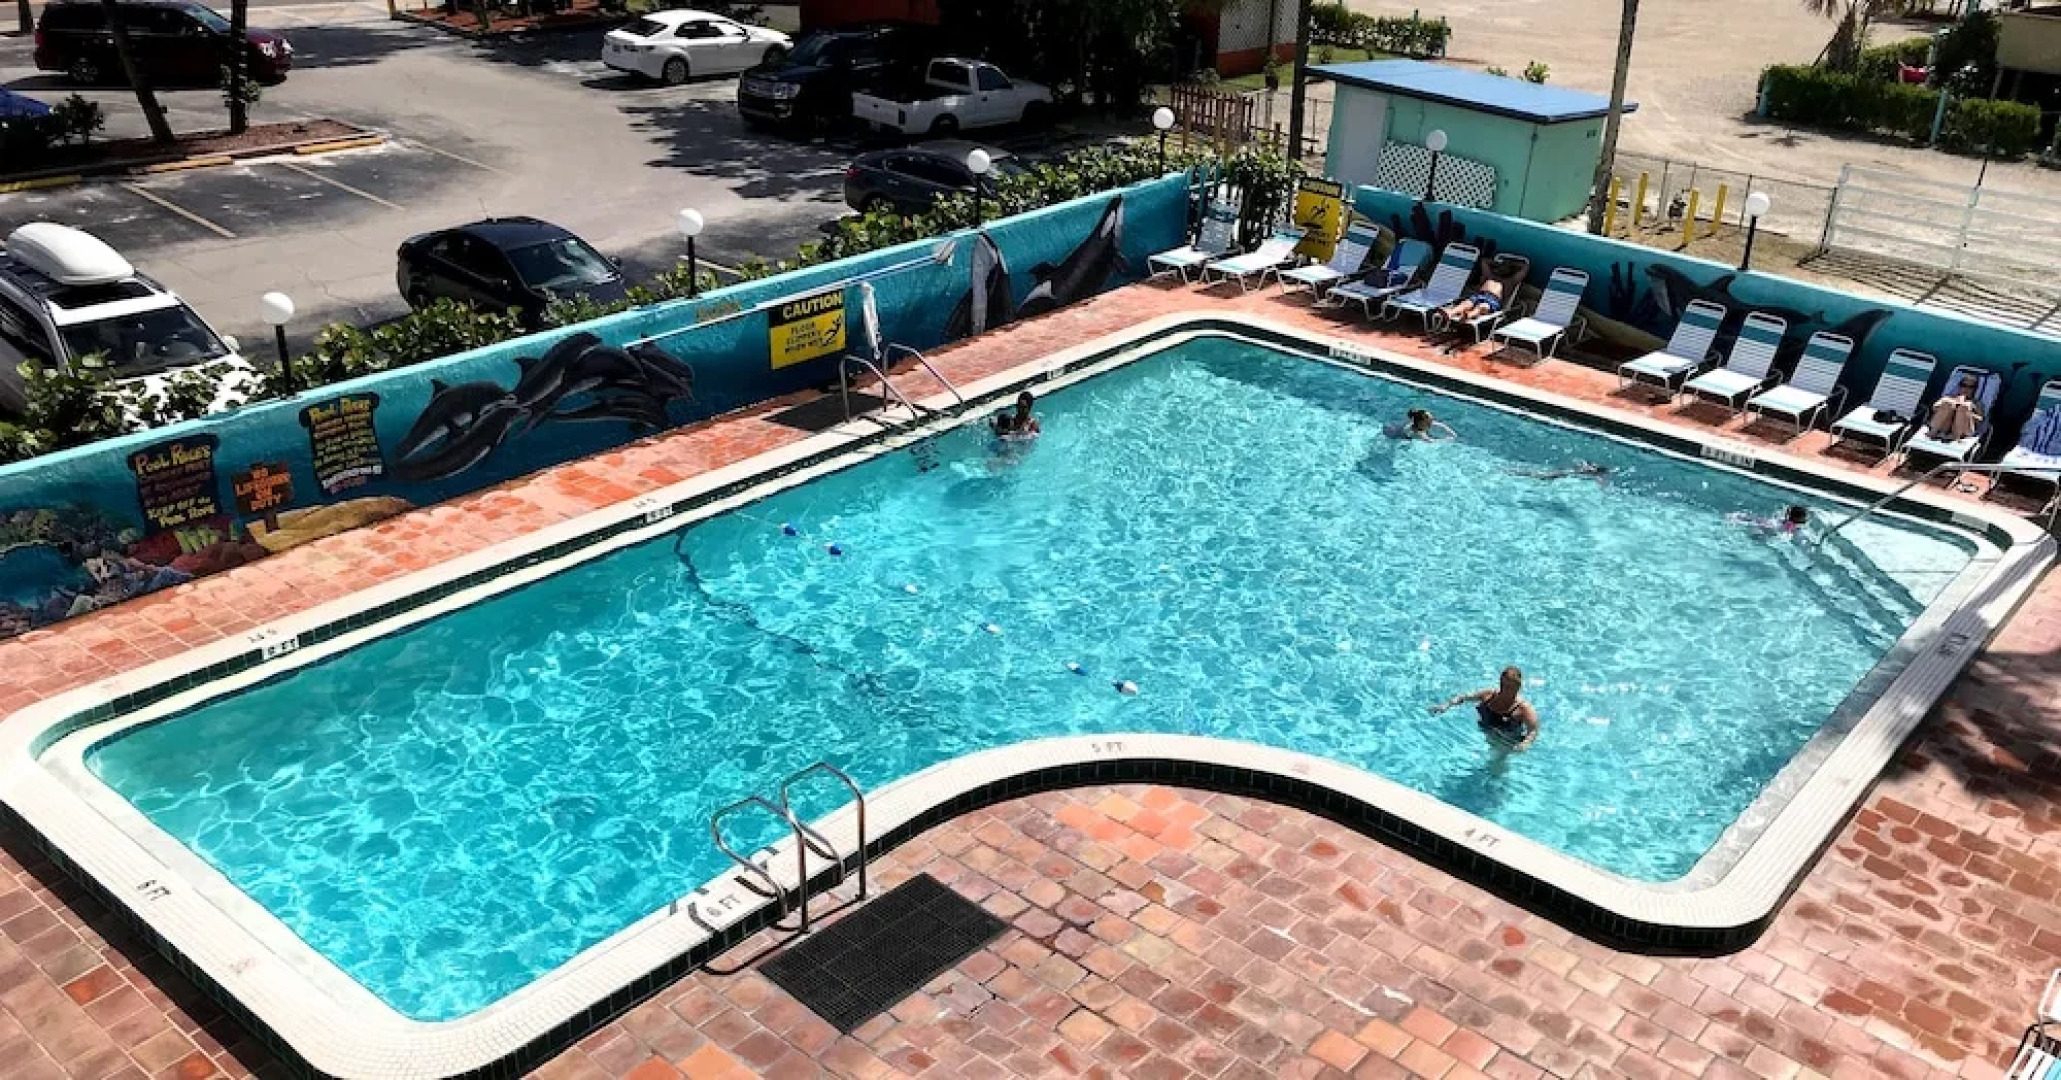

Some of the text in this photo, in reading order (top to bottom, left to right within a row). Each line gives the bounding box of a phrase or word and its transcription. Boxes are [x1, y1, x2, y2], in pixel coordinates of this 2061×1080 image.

[783, 291, 842, 319] CAUTION
[1106, 741, 1122, 753] FT
[1479, 833, 1501, 848] FT
[145, 885, 171, 901] FT
[718, 893, 741, 910] FT
